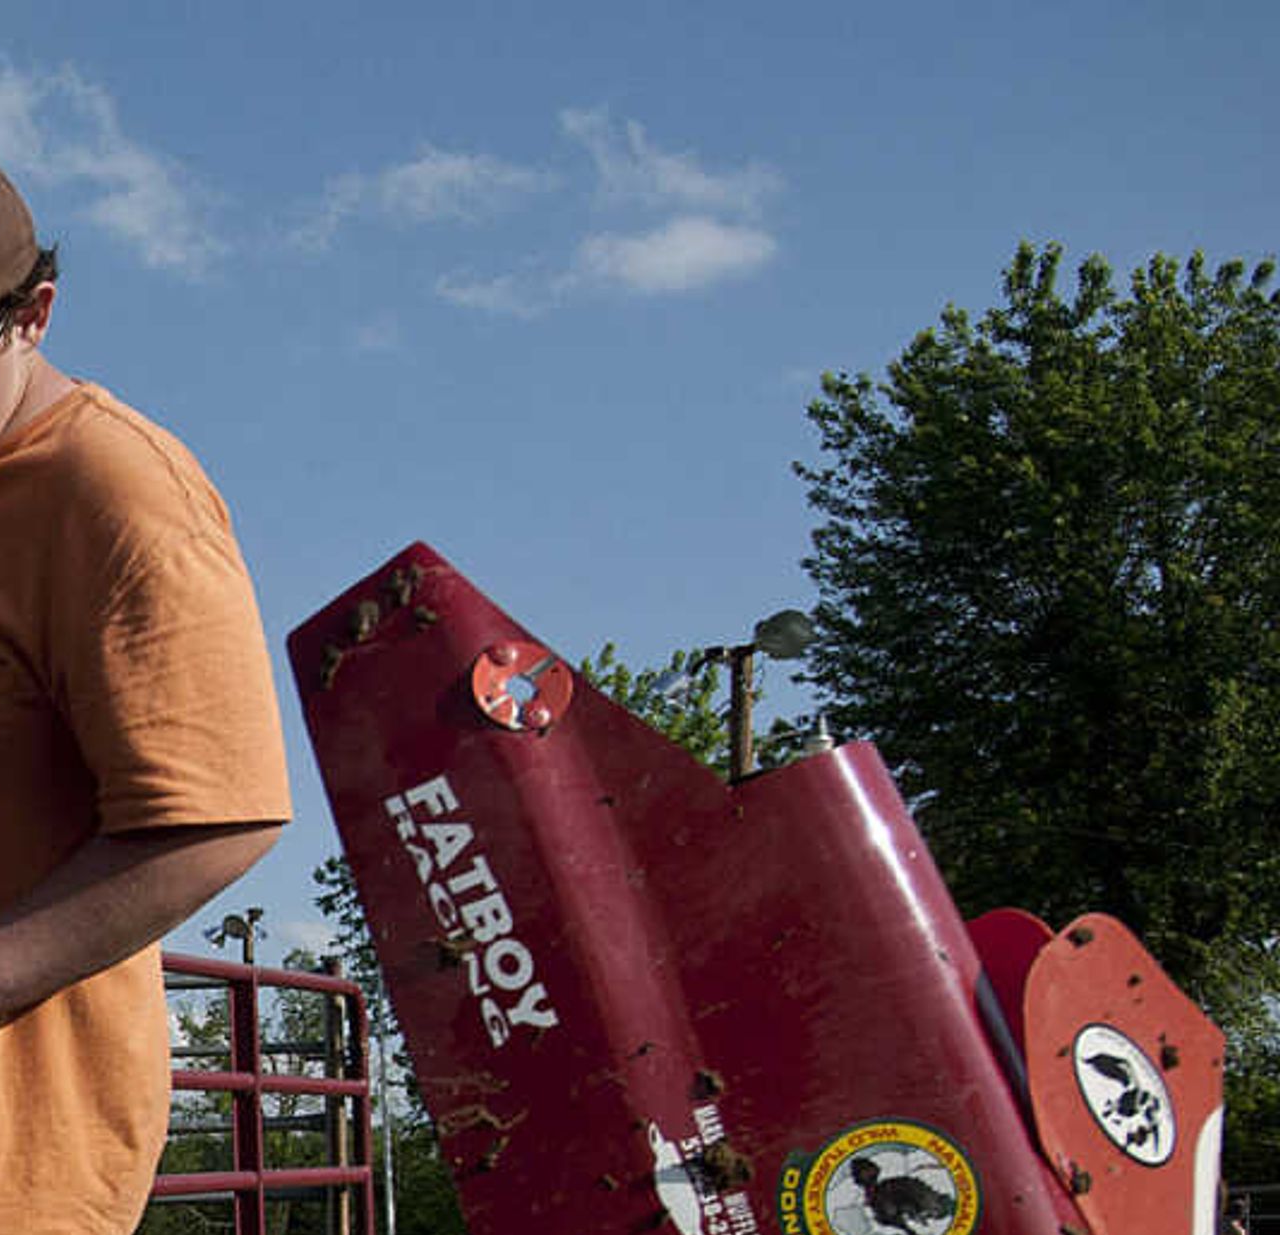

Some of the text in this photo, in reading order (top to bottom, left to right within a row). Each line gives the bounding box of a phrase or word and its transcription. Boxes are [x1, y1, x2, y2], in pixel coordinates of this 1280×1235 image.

[384, 795, 510, 1048] RACING
[404, 774, 559, 1029] FATBOY
[806, 1146, 846, 1215] TURKEY
[847, 1127, 899, 1148] WILD
[926, 1137, 974, 1231] NATIONAL
